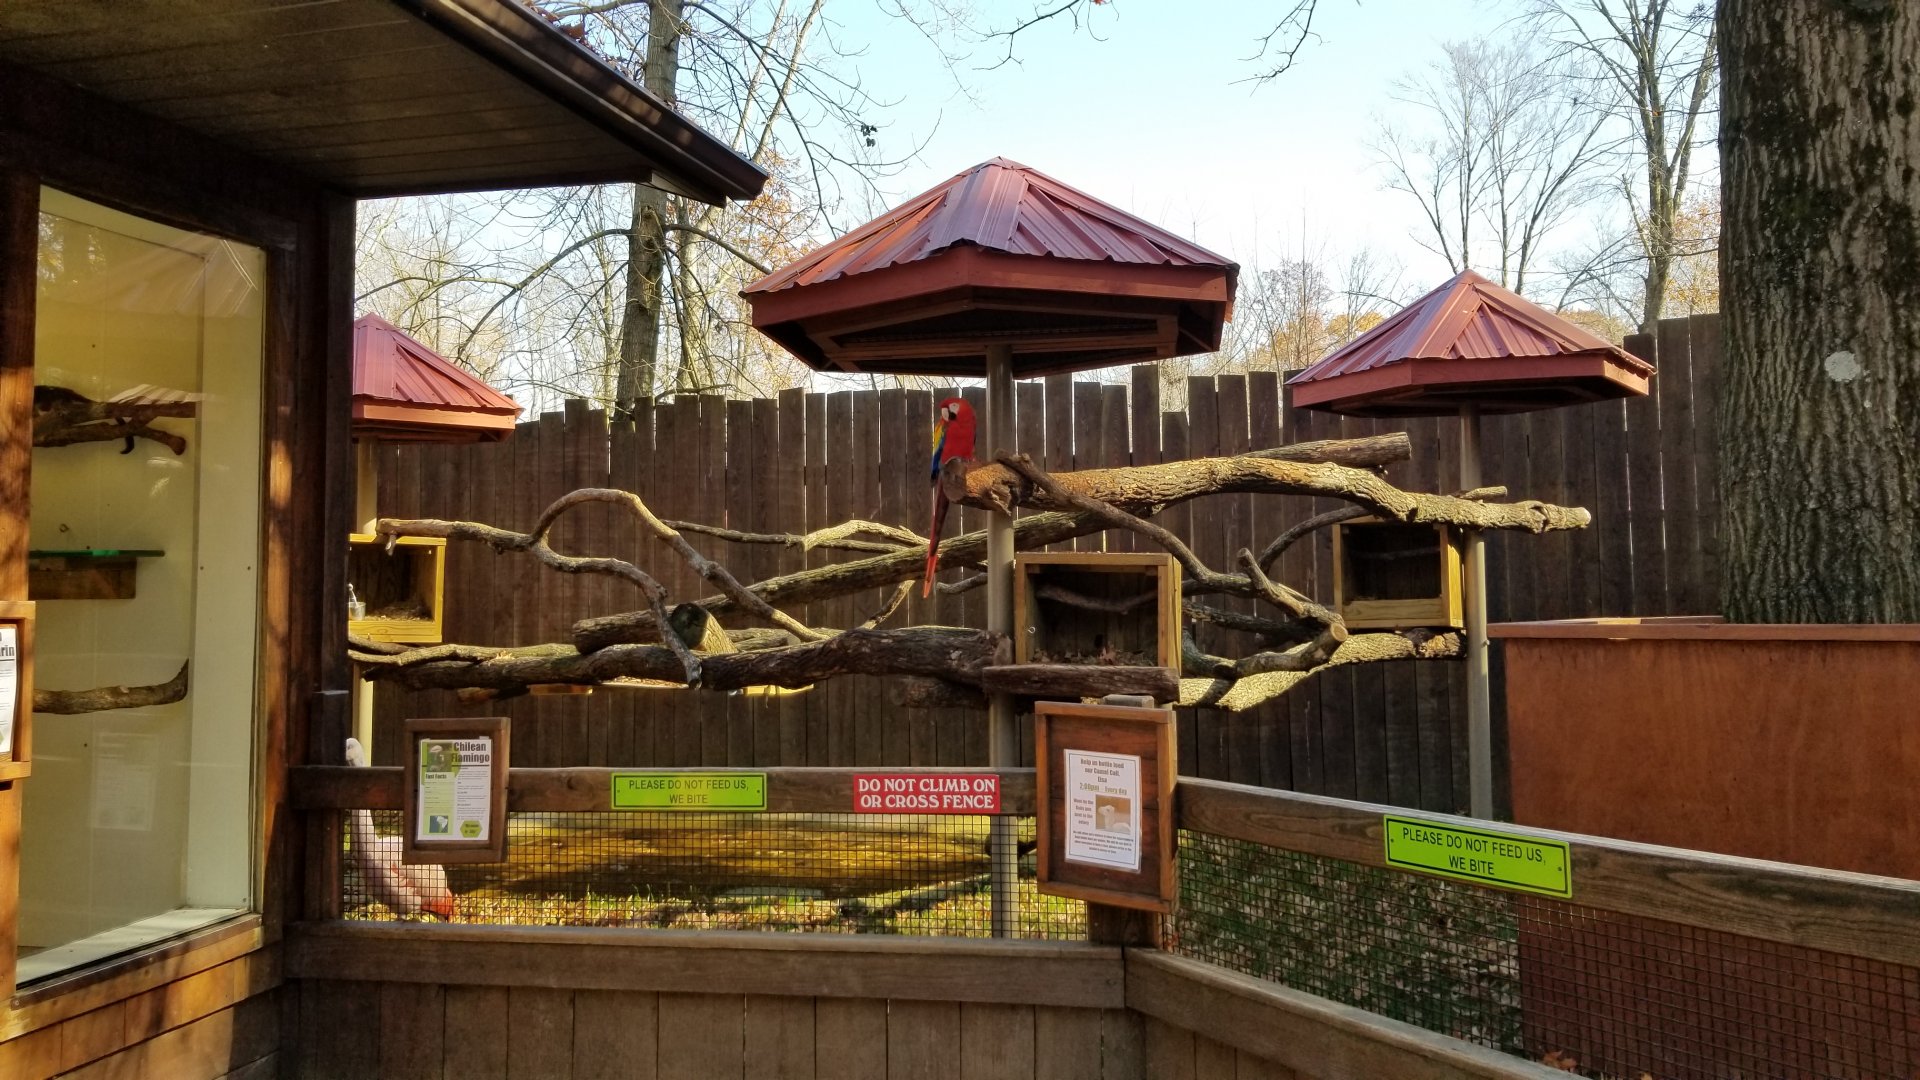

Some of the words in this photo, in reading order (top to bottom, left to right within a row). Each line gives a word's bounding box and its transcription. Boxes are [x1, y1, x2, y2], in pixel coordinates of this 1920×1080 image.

[0, 644, 15, 657] rin
[453, 741, 487, 752] Chilean
[451, 752, 490, 763] Flamingo
[628, 779, 665, 790] PLEASE
[667, 779, 682, 790] DO
[684, 779, 703, 790] NOT
[706, 779, 731, 790] FEED
[733, 780, 749, 791] US,
[858, 778, 881, 792] DO
[884, 778, 916, 792] NOT
[919, 778, 970, 792] CLIMB
[973, 778, 996, 792] ON
[669, 794, 684, 804] WE
[686, 794, 708, 804] BITE
[860, 794, 882, 808] OR
[885, 794, 940, 808] CROSS
[942, 794, 995, 808] FENCE
[1402, 827, 1442, 846] PLEASE
[1446, 834, 1462, 849] DO
[1465, 838, 1489, 854] NOT
[1492, 843, 1523, 859] FEED
[1526, 847, 1546, 866] US,
[1448, 855, 1466, 871] WE
[1469, 858, 1495, 875] BITE
